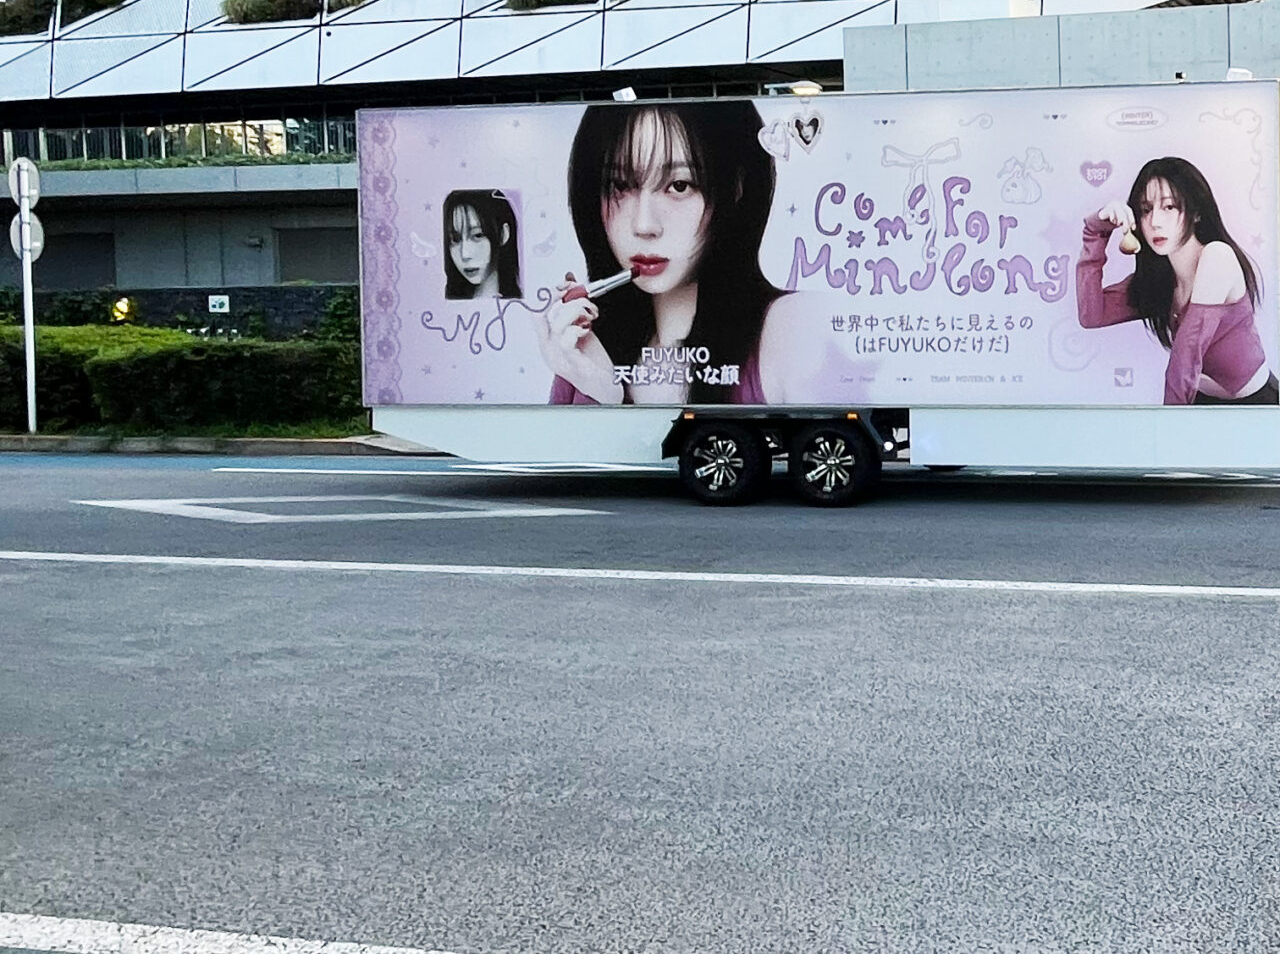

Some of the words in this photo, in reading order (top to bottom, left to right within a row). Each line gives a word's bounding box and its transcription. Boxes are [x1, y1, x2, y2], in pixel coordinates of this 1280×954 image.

[831, 314, 1034, 333] 世界中で私たちに見えるの
[641, 346, 711, 364] FUYUKO
[613, 365, 740, 385] 天使みたいな顔
